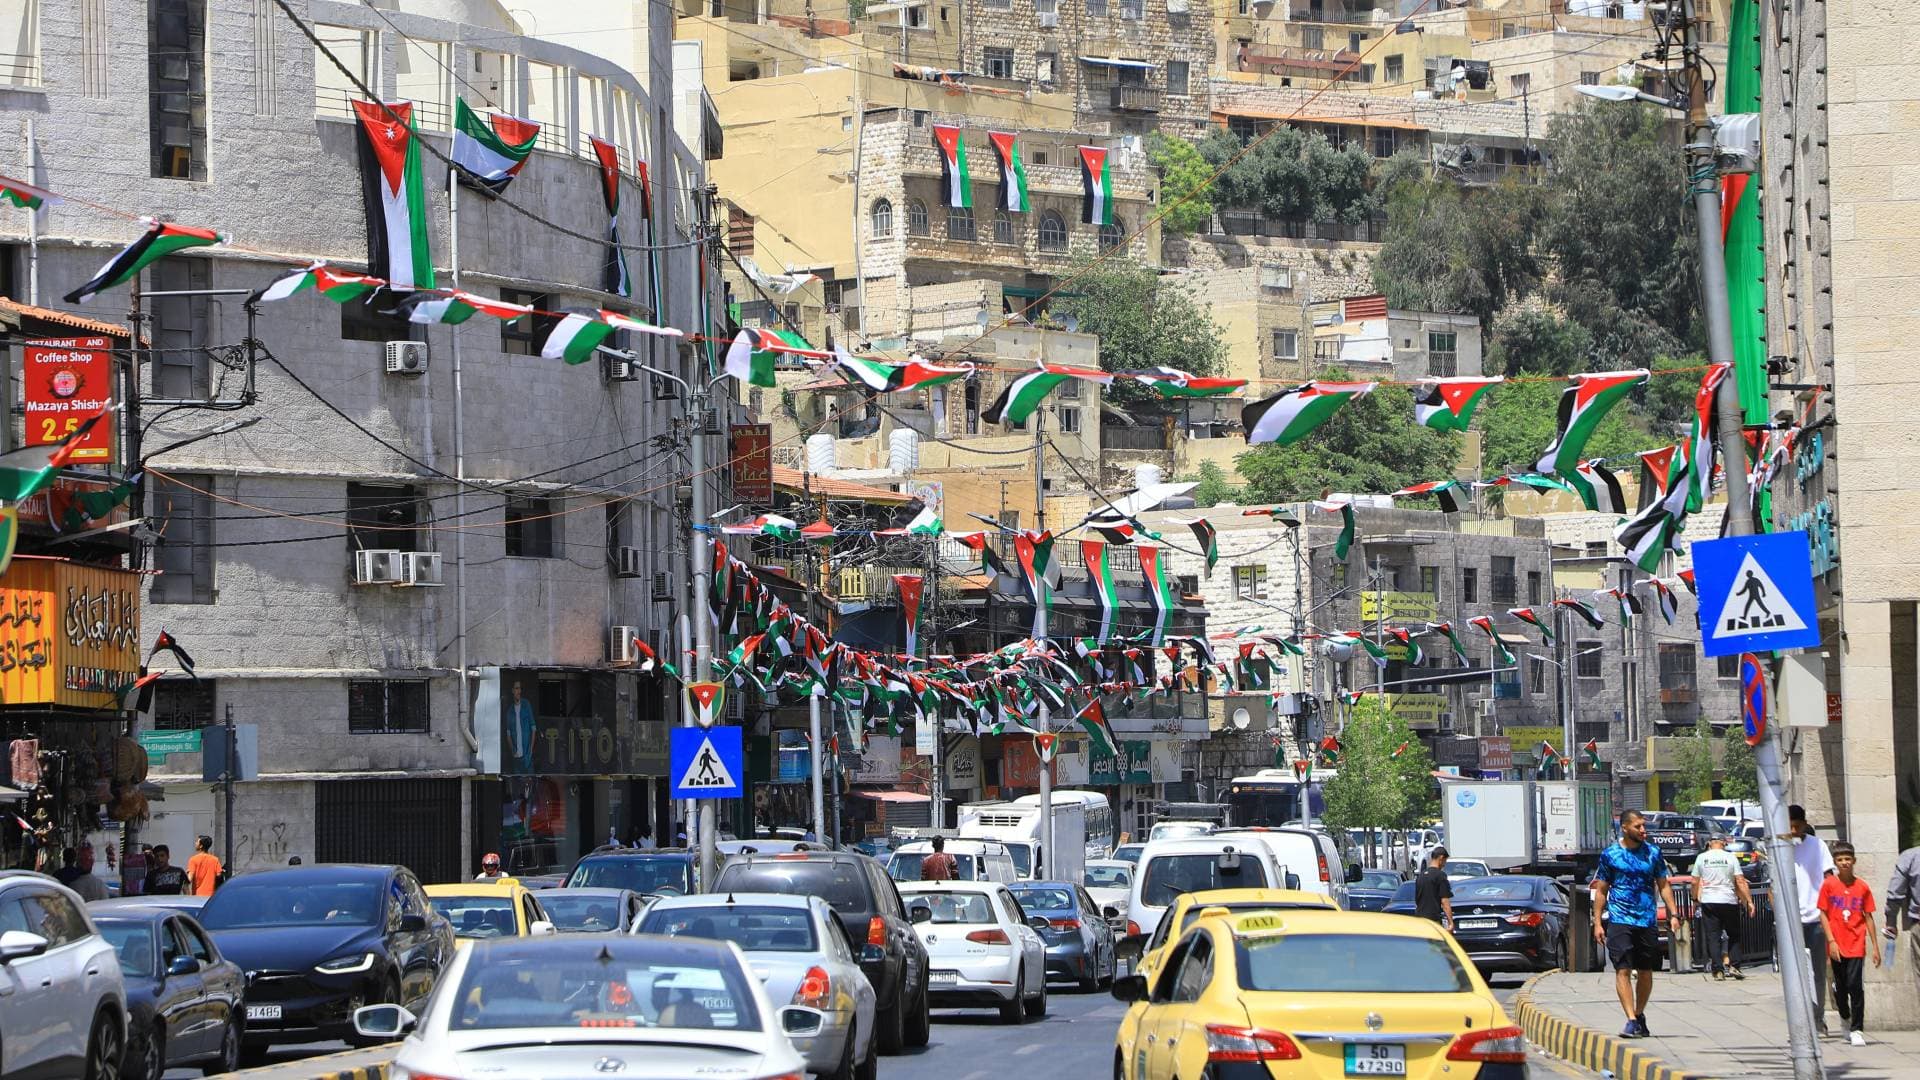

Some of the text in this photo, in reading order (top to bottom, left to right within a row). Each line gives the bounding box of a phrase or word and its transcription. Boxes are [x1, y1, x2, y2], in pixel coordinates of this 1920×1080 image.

[86, 338, 104, 347] AND
[35, 351, 93, 364] Coffee Shop
[26, 401, 69, 413] Mazaya
[41, 417, 79, 442] 2.5
[545, 728, 614, 764] TITO
[1653, 836, 1685, 844] TOYOTA
[1244, 917, 1275, 929] TAXI
[1371, 1045, 1389, 1060] 50
[1357, 1060, 1403, 1073] 47290
